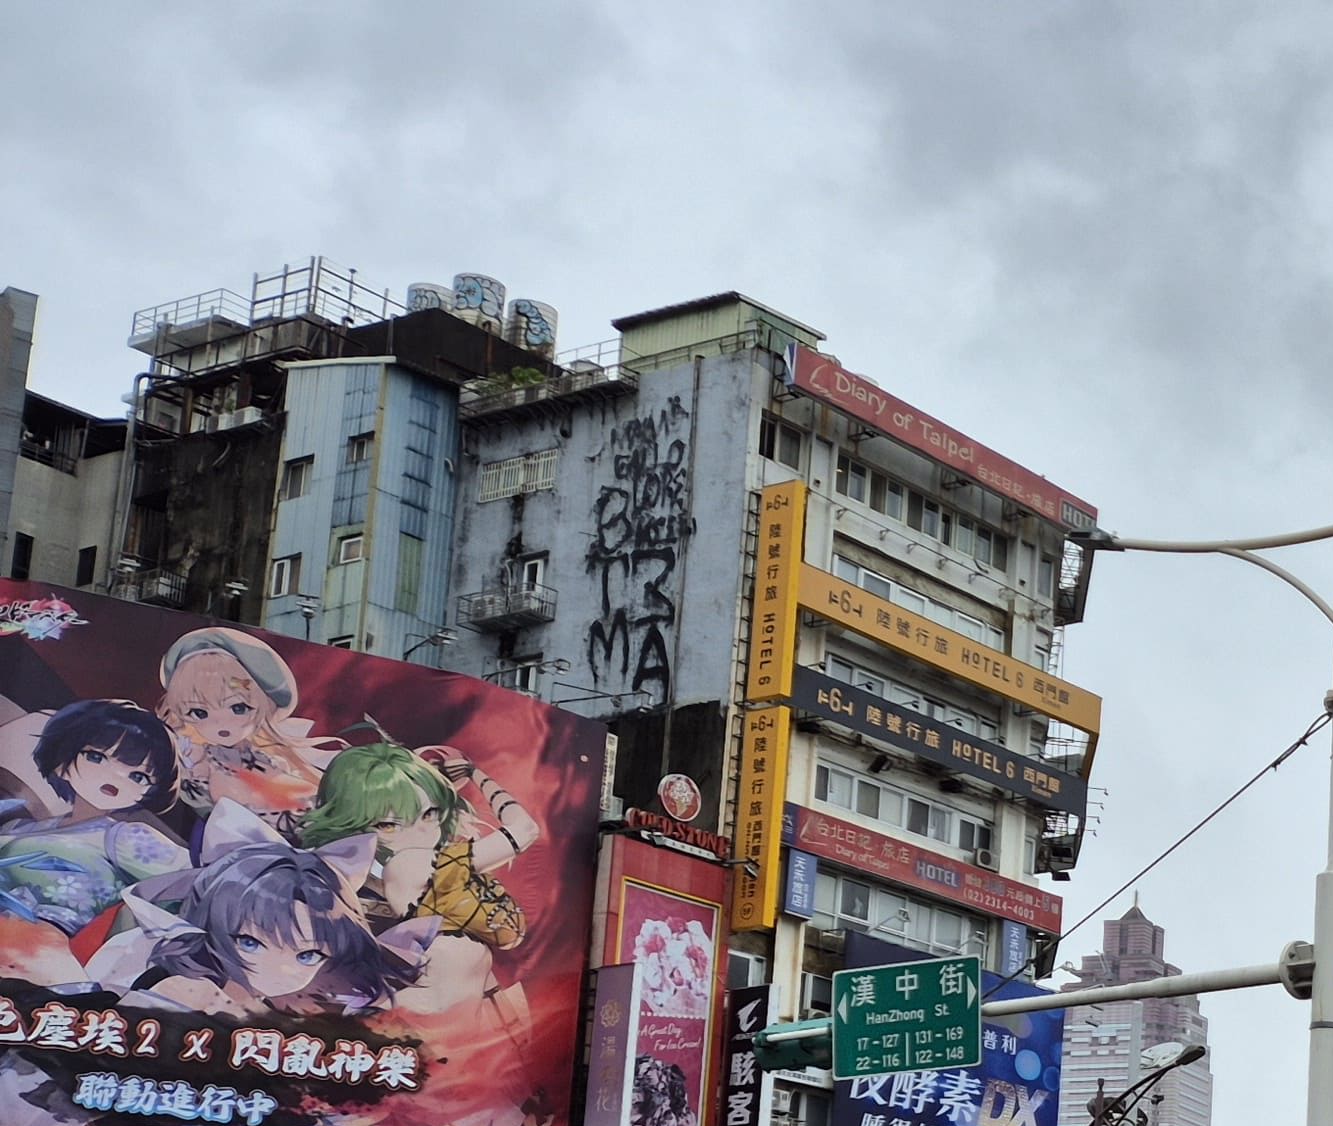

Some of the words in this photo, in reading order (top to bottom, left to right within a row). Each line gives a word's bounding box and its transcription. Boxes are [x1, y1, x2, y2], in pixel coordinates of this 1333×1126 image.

[834, 371, 887, 415] Diary
[893, 411, 915, 431] of
[919, 419, 975, 463] Taipei
[759, 612, 777, 670] HOTEL
[961, 646, 1010, 684] HOTEL
[1015, 671, 1025, 689] 6
[951, 738, 1003, 775] HOTEL
[1005, 763, 1016, 780] 6
[915, 859, 960, 889] HOTEL
[850, 963, 966, 1008] 漢中街
[866, 1008, 925, 1026] HanZhong
[231, 1028, 419, 1091] 閃亂神樂
[983, 1029, 1018, 1056] 普利
[74, 1072, 279, 1126] 聯動進行中
[727, 1051, 756, 1126] 駭客
